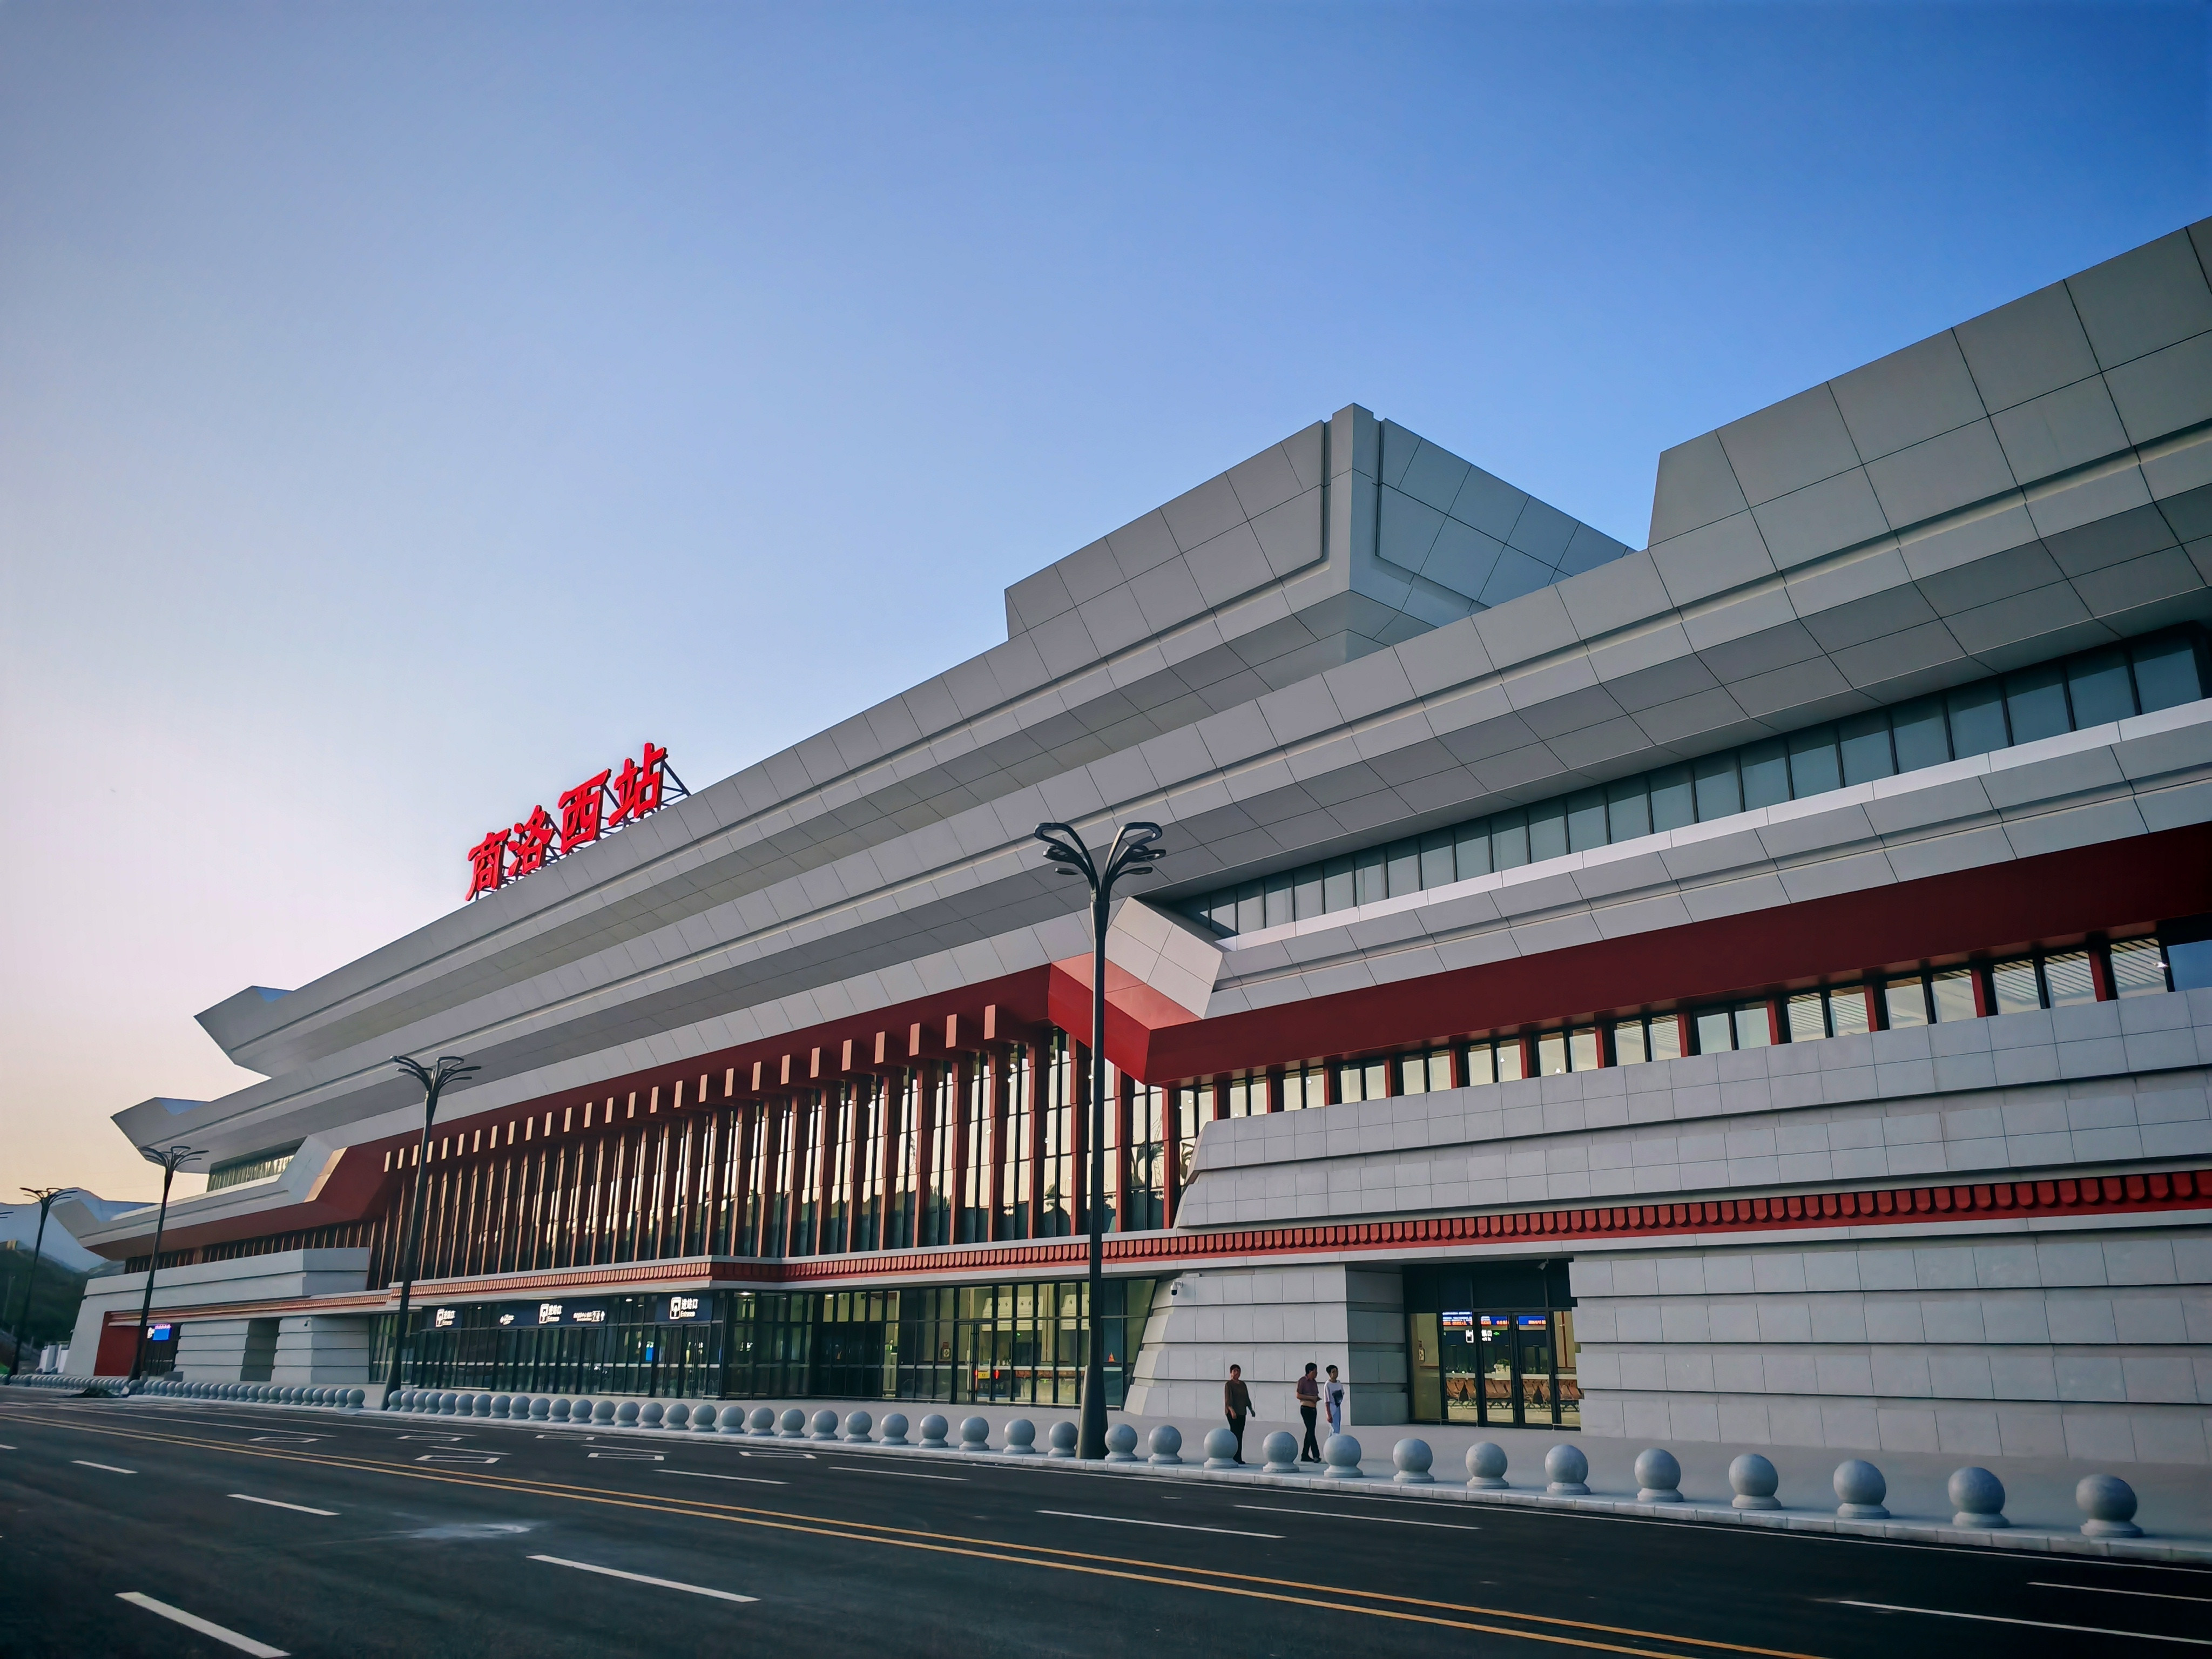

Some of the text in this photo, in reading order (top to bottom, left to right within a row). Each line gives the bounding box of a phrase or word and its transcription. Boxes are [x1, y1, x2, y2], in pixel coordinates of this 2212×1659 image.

[465, 742, 666, 901] 商洛西站
[681, 1298, 699, 1310] 进站口
